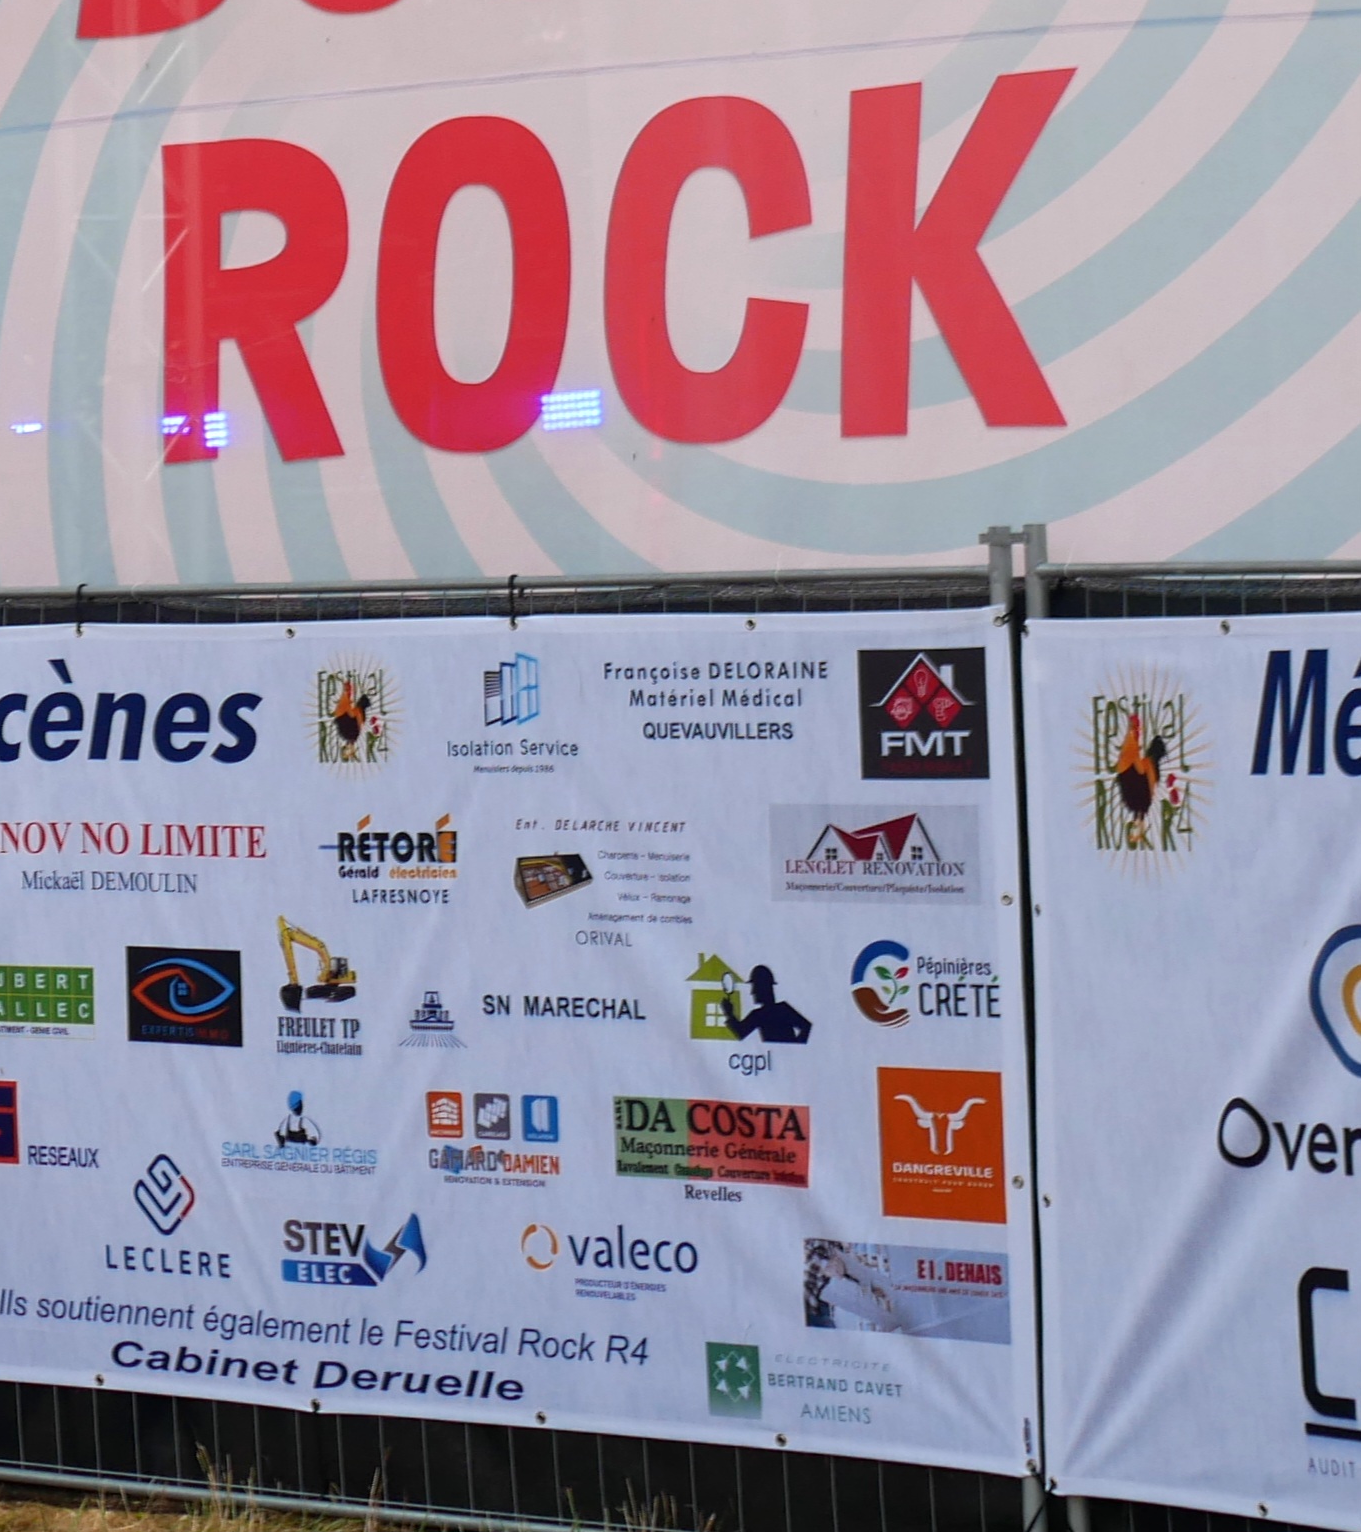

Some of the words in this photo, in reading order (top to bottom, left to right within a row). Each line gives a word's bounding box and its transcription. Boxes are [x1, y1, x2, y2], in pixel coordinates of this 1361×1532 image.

[161, 67, 1077, 465] ROCK
[603, 662, 701, 685] Françoise
[708, 661, 828, 680] DELORAINE
[629, 688, 715, 708] Matériel
[721, 687, 803, 708] Médical
[643, 722, 794, 741] QUEVAUVILLERS
[880, 730, 972, 757] FMT
[447, 739, 513, 758] Isolation
[520, 738, 579, 758] Service
[554, 819, 620, 832] DELARCHE
[628, 821, 687, 833] VINCENT
[80, 822, 130, 855] NO
[140, 823, 268, 859] LIMITE
[337, 814, 458, 863] RÉTORÉ
[338, 865, 379, 879] Gérald
[785, 859, 857, 875] LENGLET
[21, 870, 85, 891] Mickaël
[91, 871, 198, 893] DEMOULIN
[352, 889, 450, 904] LAFRESNOYE
[575, 930, 633, 947] ORIVAL
[917, 956, 992, 979] Pépinières
[482, 994, 512, 1016] SN
[523, 995, 647, 1020] MARECHAL
[919, 975, 1003, 1018] CRÉTÉ
[277, 1016, 336, 1038] FREULET
[341, 1018, 360, 1039] TP
[728, 1050, 772, 1076] cgpl
[625, 1099, 676, 1133] DA
[686, 1102, 807, 1141] COSTA
[27, 1144, 100, 1169] RESEAUX
[221, 1141, 259, 1159] SARL
[263, 1144, 328, 1162] SAGNIER
[332, 1145, 378, 1165] RÉGIS
[620, 1137, 719, 1159] Maçonnerie
[725, 1141, 796, 1164] Générale
[502, 1152, 561, 1175] DAMIEN
[892, 1162, 994, 1179] DANGREVILLE
[684, 1184, 742, 1203] Revelles
[283, 1219, 367, 1258] STEV
[567, 1224, 699, 1274] valeco
[104, 1244, 233, 1279] LECLERE
[944, 1261, 1003, 1286] DEHAIS
[296, 1263, 353, 1285] ELEC
[36, 1294, 195, 1331] soutiennent
[202, 1305, 352, 1346] également
[360, 1317, 384, 1347] le
[394, 1318, 510, 1356] Festival
[518, 1326, 596, 1363] Rock
[605, 1334, 650, 1366] R4
[111, 1340, 299, 1387] Cabinet
[313, 1359, 525, 1402] Deruelle
[767, 1372, 850, 1393] BERTRAND
[855, 1379, 904, 1398] CAVET
[800, 1402, 872, 1425] AMIENS
